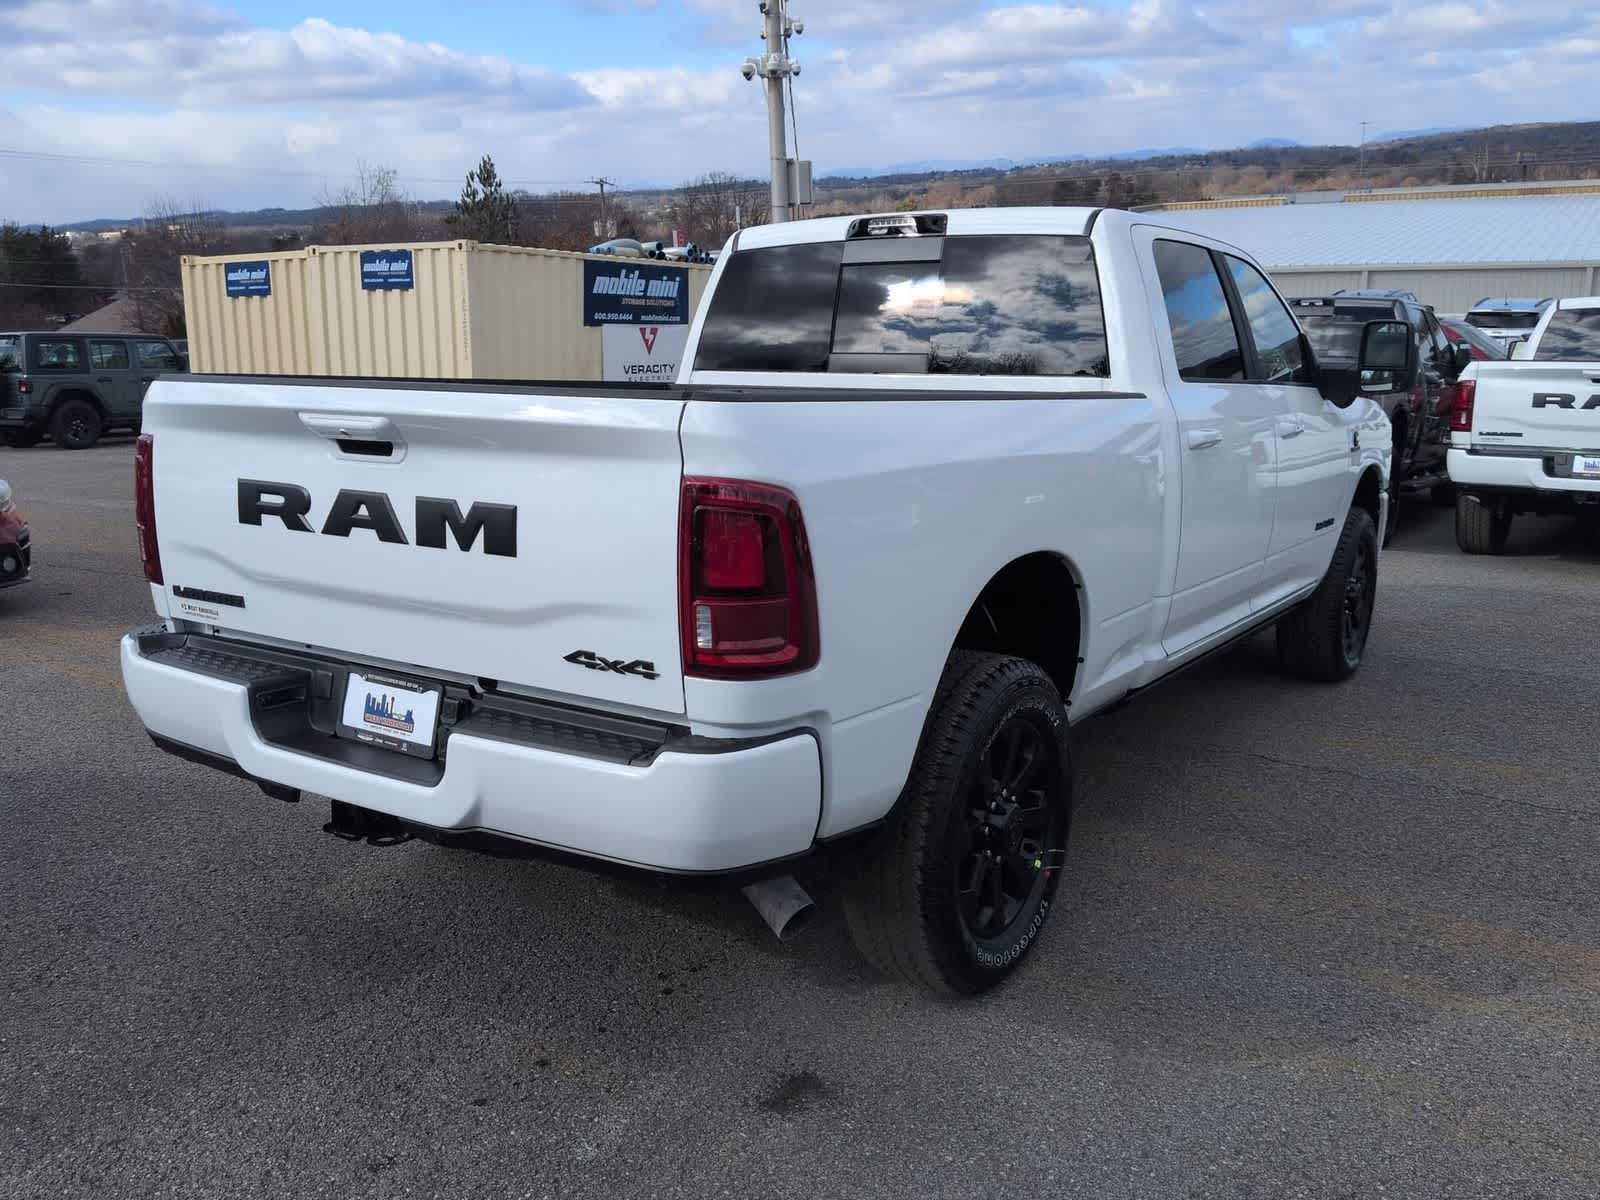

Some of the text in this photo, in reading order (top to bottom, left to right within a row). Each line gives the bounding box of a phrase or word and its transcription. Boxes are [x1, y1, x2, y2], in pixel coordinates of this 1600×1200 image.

[592, 269, 681, 298] mobile mini
[623, 363, 676, 375] VERACITY
[237, 477, 518, 558] RAM
